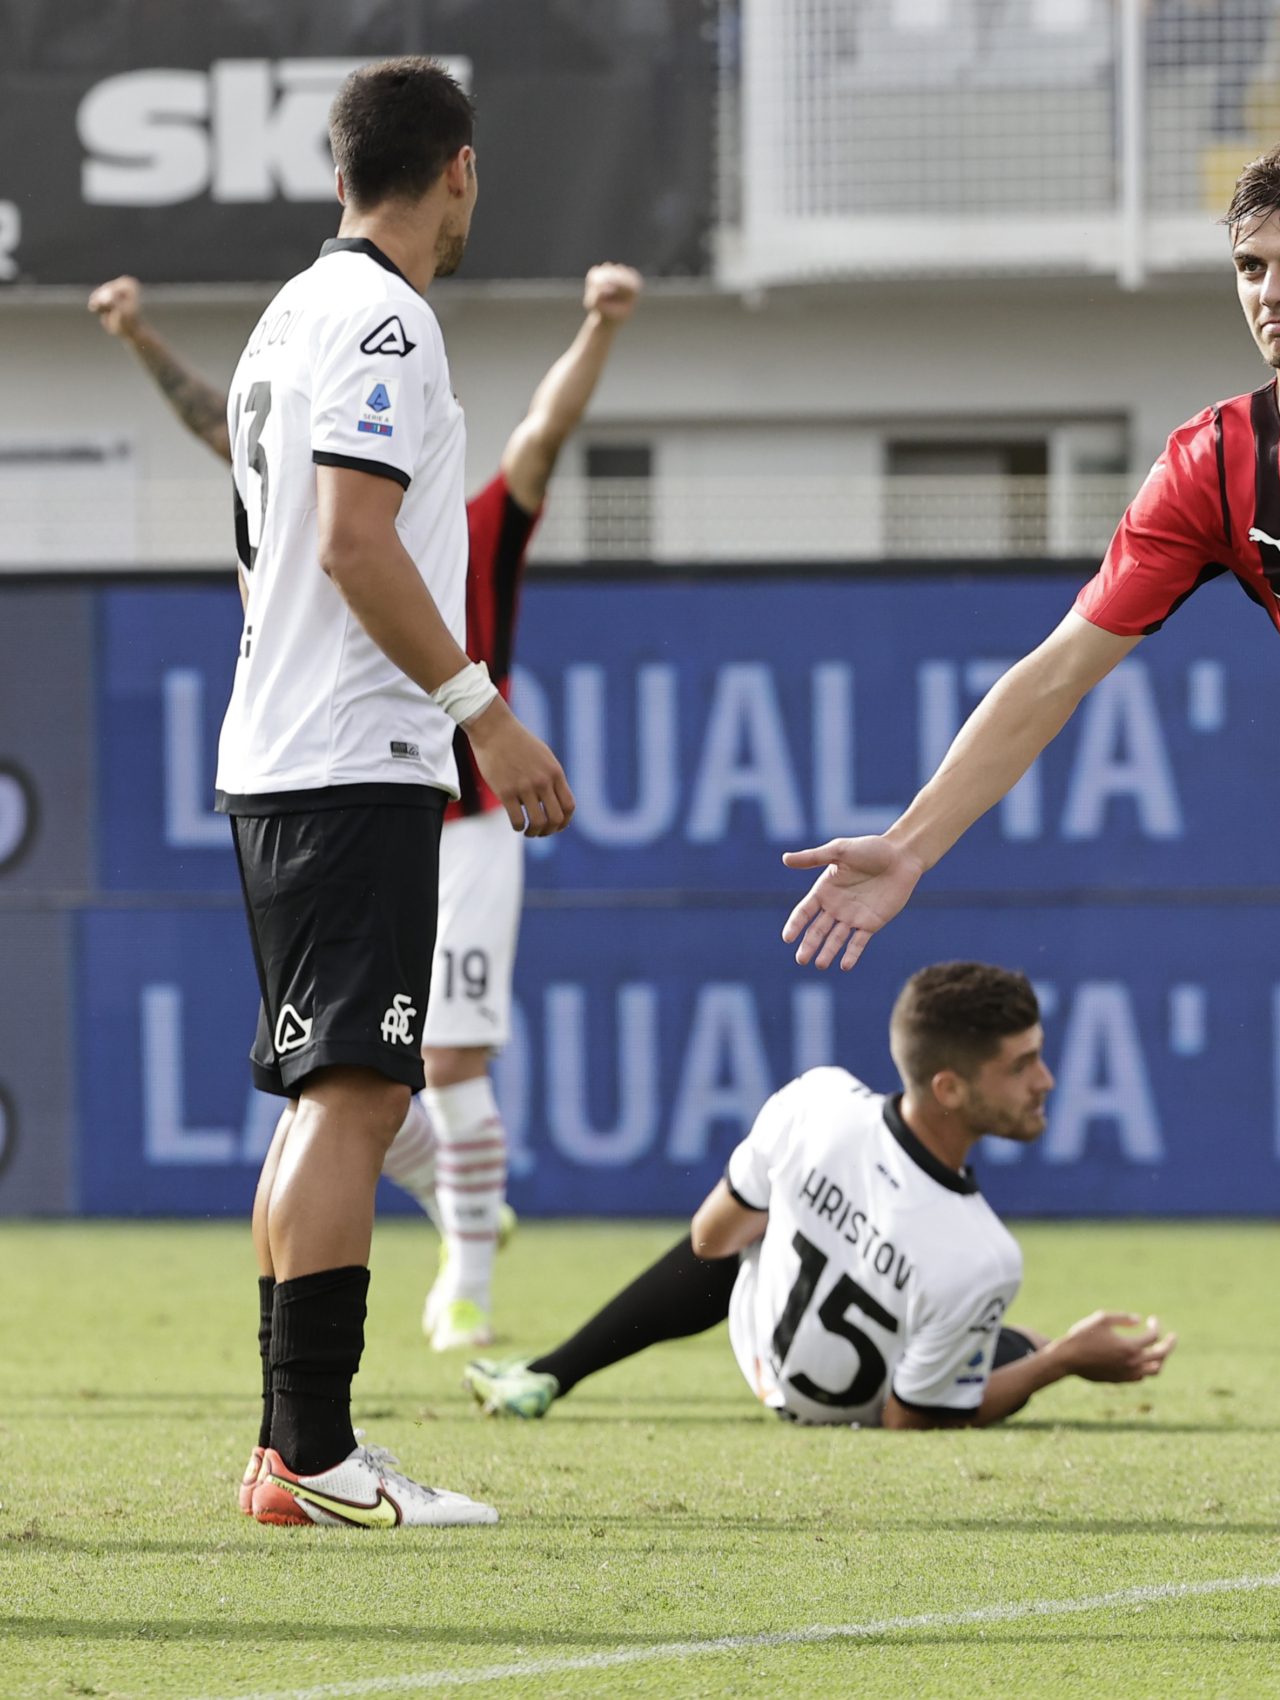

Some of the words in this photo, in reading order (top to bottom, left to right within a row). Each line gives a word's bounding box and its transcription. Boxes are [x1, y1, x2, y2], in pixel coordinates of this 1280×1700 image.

[441, 949, 489, 1002] 19
[140, 981, 290, 1168] L
[799, 1167, 914, 1293] HRISTOV
[773, 1228, 899, 1408] 15
